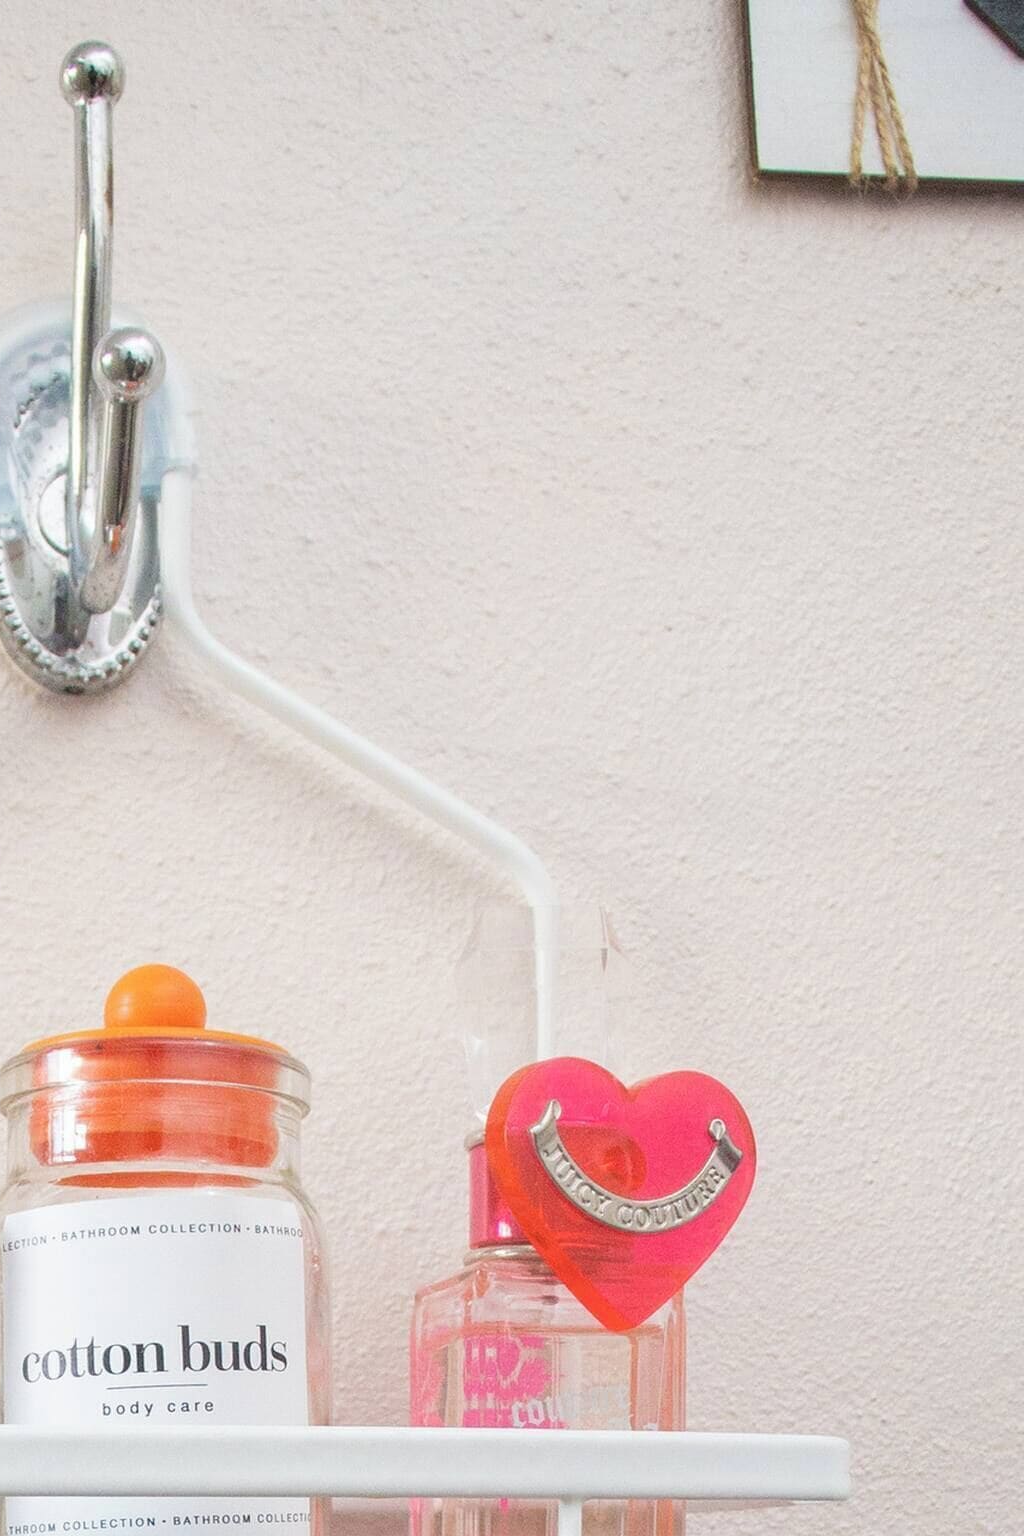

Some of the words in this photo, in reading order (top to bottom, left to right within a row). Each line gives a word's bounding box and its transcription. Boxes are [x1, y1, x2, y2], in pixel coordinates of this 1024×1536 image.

[543, 1144, 612, 1216] JUICY
[617, 1166, 725, 1228] COUTURE
[61, 1225, 140, 1242] BATHROOM
[148, 1223, 241, 1234] COLLECTION
[22, 1336, 168, 1384] cotton
[178, 1324, 287, 1373] buds
[102, 1401, 154, 1417] body
[167, 1400, 215, 1414] care
[63, 1517, 156, 1531] COLLECTION
[173, 1514, 251, 1526] BATHROOM
